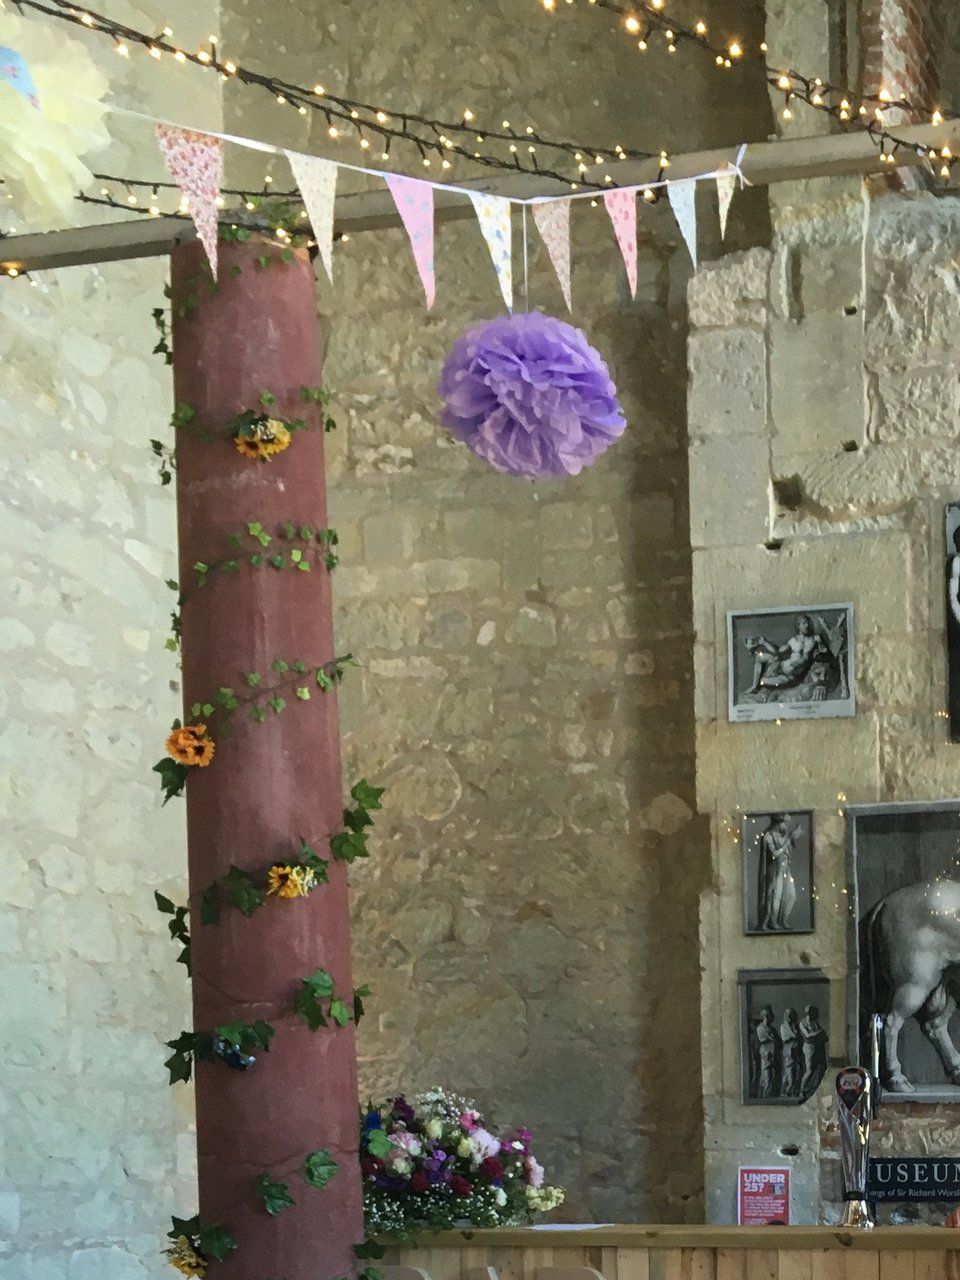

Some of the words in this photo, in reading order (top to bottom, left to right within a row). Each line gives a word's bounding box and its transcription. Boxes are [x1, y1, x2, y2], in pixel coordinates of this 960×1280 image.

[743, 1173, 786, 1183] UNDER
[743, 1182, 765, 1193] 25?
[908, 1188, 936, 1197] Richard
